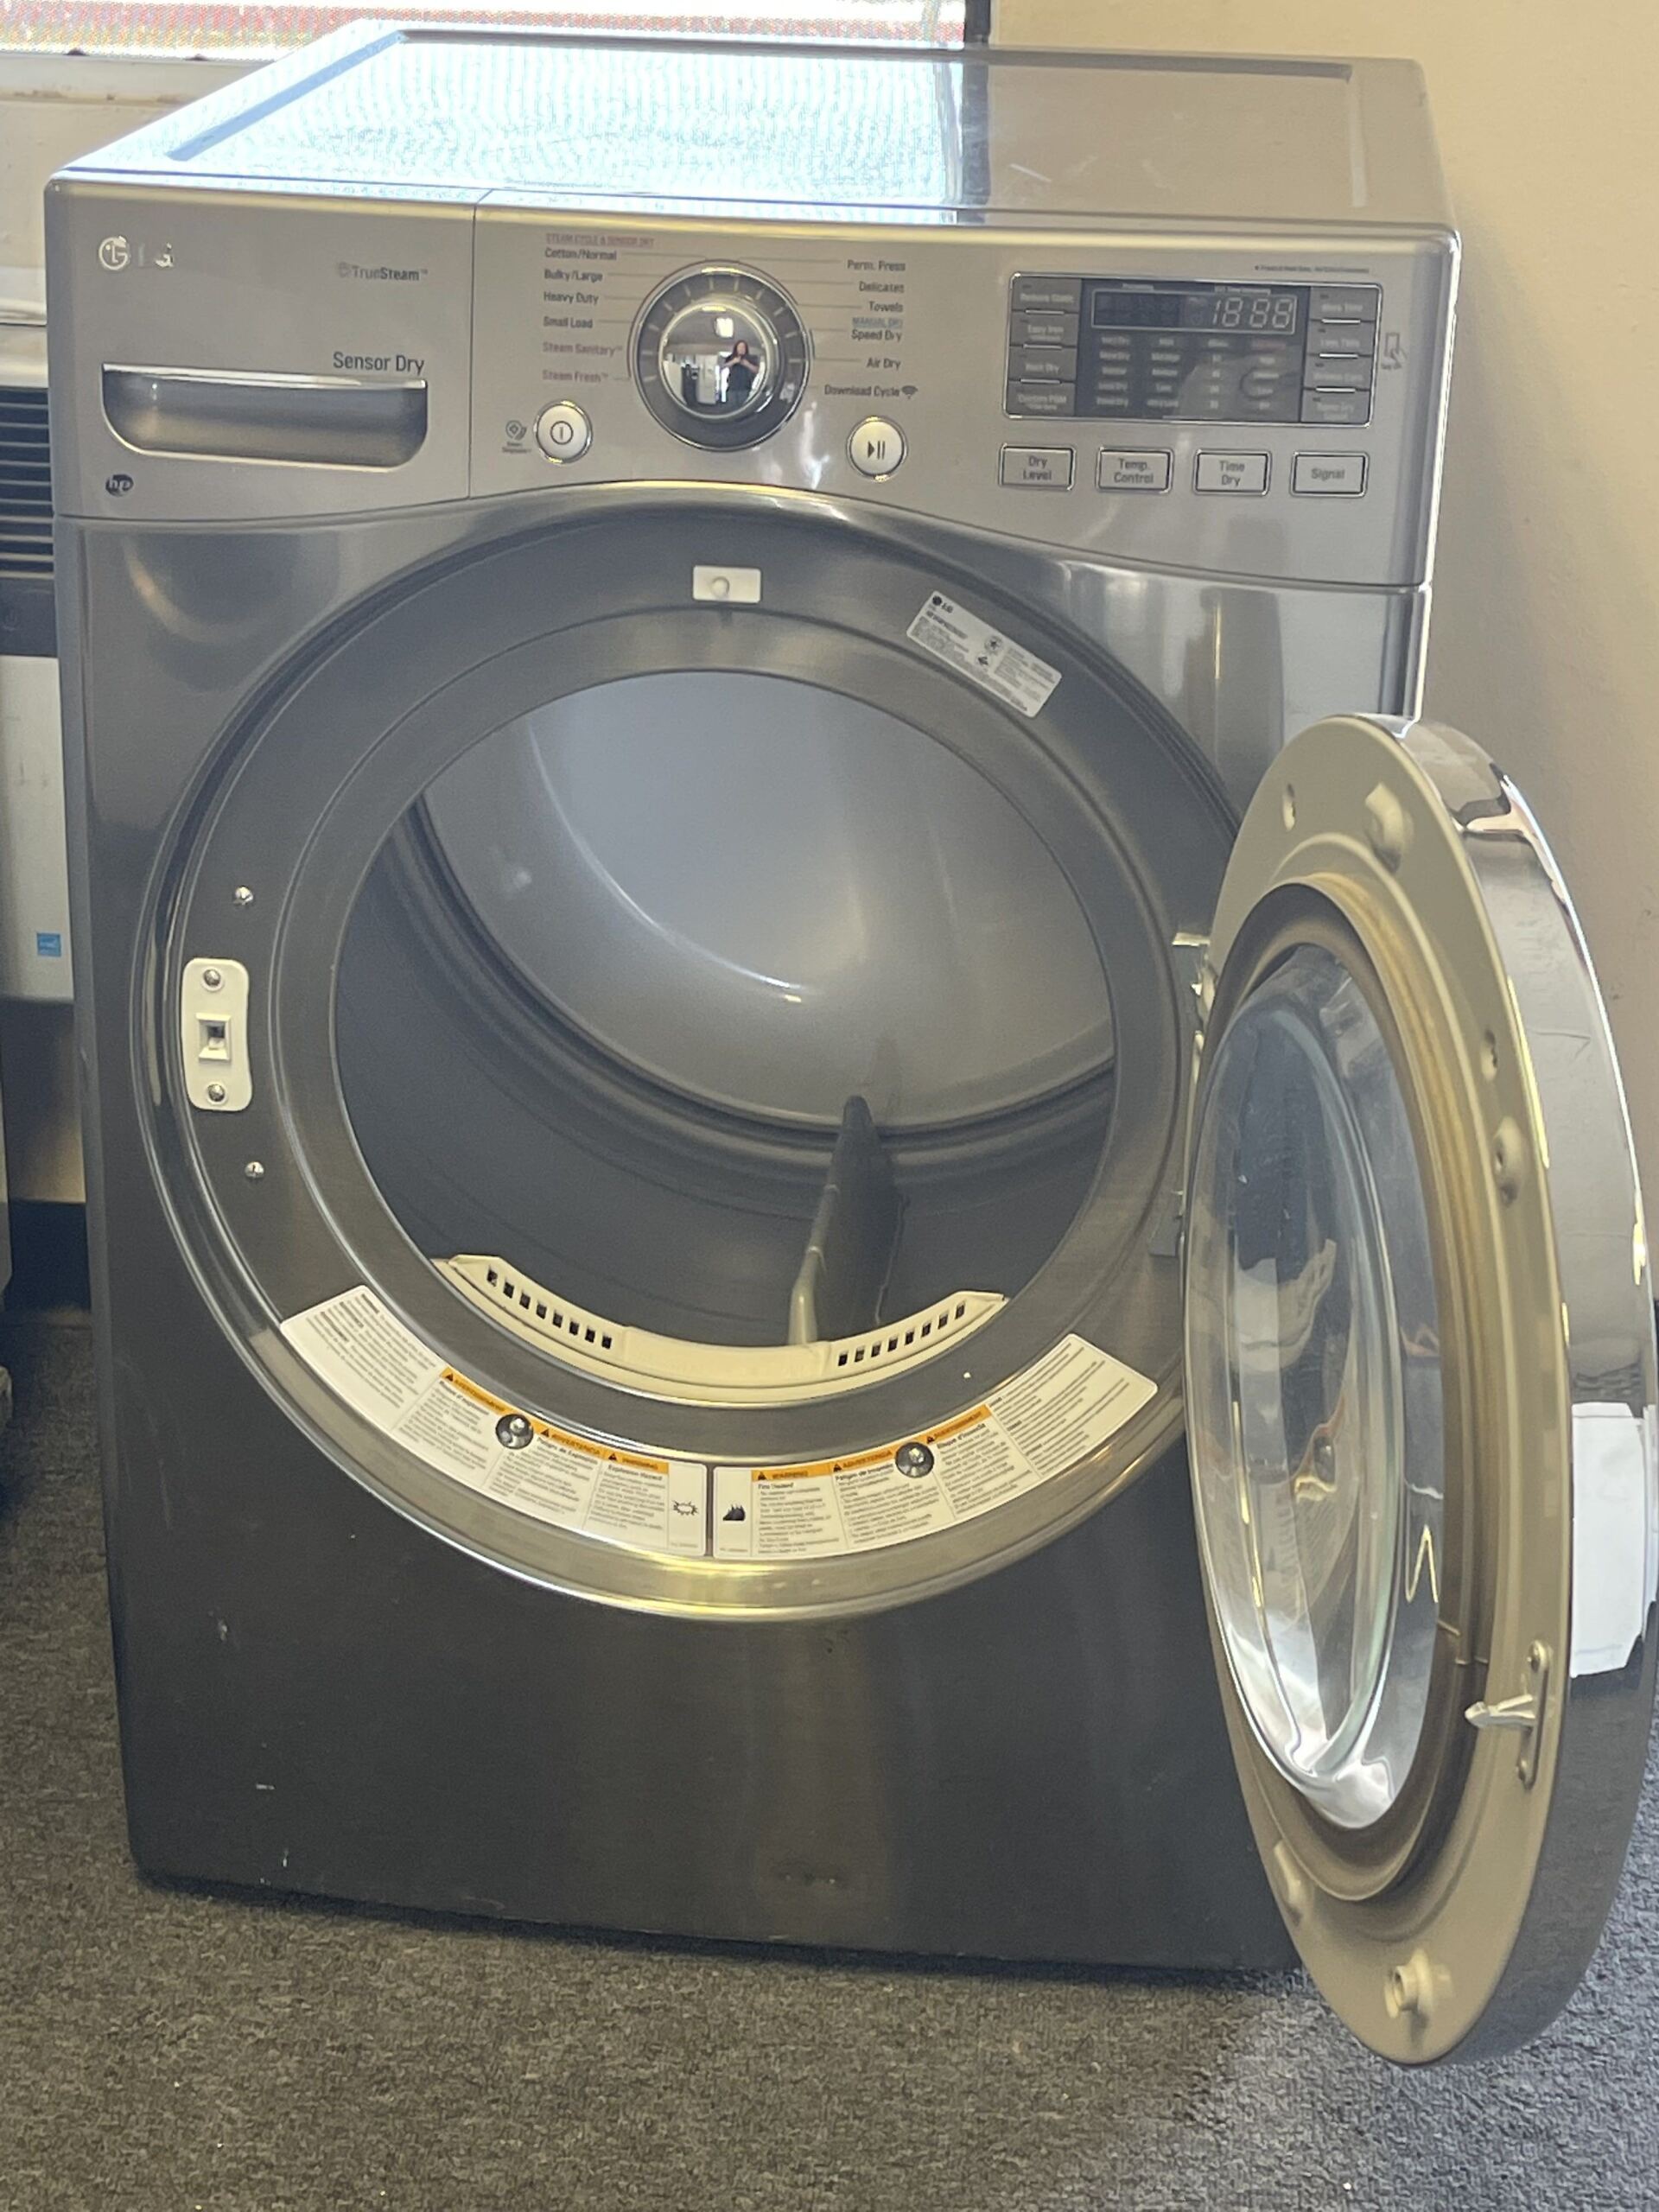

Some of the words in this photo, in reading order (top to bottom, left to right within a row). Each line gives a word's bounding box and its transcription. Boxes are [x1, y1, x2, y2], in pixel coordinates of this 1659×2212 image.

[544, 247, 618, 261] Cotton/Normal
[878, 260, 906, 271] Press
[858, 281, 905, 294] Delicates
[543, 291, 574, 303] Heavy
[576, 292, 600, 306] Duty
[868, 301, 904, 312] Towels
[543, 316, 569, 327] Small
[570, 317, 593, 328] Load
[850, 328, 883, 340] Speed
[884, 329, 903, 341] Dry
[333, 350, 391, 371] Sensor
[396, 354, 425, 376] Dry
[866, 357, 880, 368] Air
[883, 358, 901, 370] Dry
[823, 384, 872, 396] Download
[873, 385, 899, 398] Cycle
[1027, 457, 1048, 469] Dry
[1217, 461, 1245, 473] Time
[1022, 468, 1052, 481] Level
[1114, 472, 1154, 484] Control
[1221, 474, 1241, 487] Dry
[1311, 468, 1345, 481] Signal
